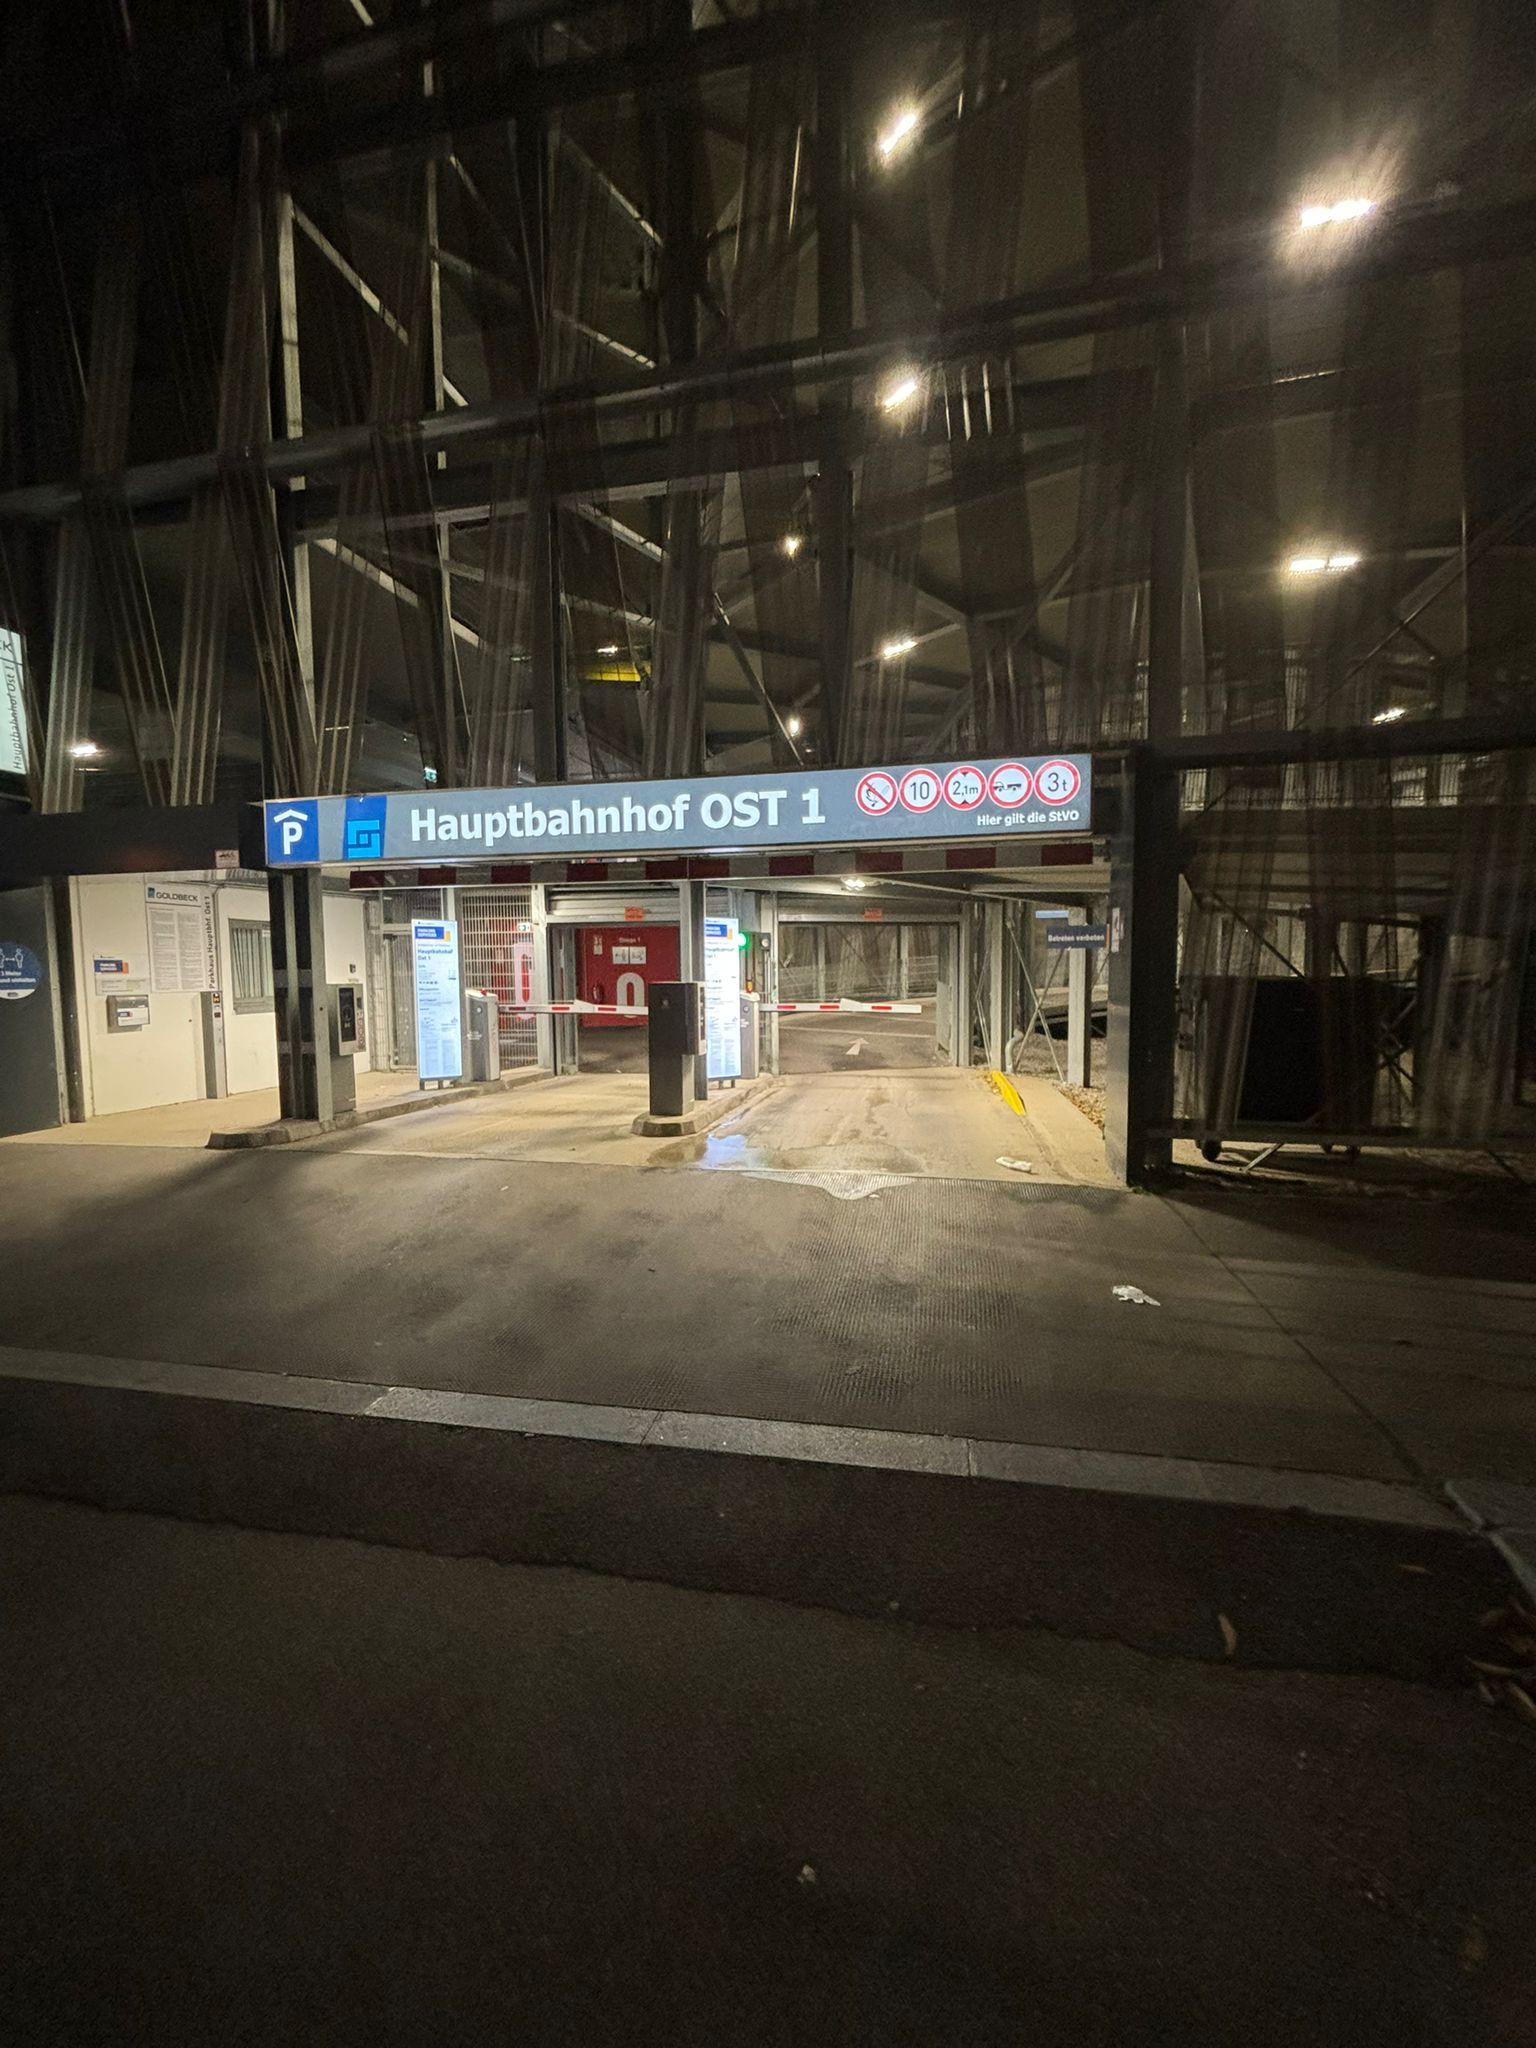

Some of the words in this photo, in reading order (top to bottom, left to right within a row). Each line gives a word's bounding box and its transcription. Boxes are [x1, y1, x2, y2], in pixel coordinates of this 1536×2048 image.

[909, 781, 930, 800] 10
[411, 793, 691, 846] Hauptbahnhof
[700, 790, 787, 830] OST
[802, 788, 826, 825] 1
[977, 814, 1002, 826] Hier
[1005, 814, 1026, 827] gilt
[1027, 812, 1046, 824] die
[1048, 810, 1080, 822] StVO
[282, 821, 303, 855] P
[156, 891, 198, 902] GOLDBECK
[1047, 934, 1075, 942] Betreten
[1076, 933, 1105, 942] verboten
[208, 955, 216, 989] Parkhaus
[616, 972, 645, 1019] 0
